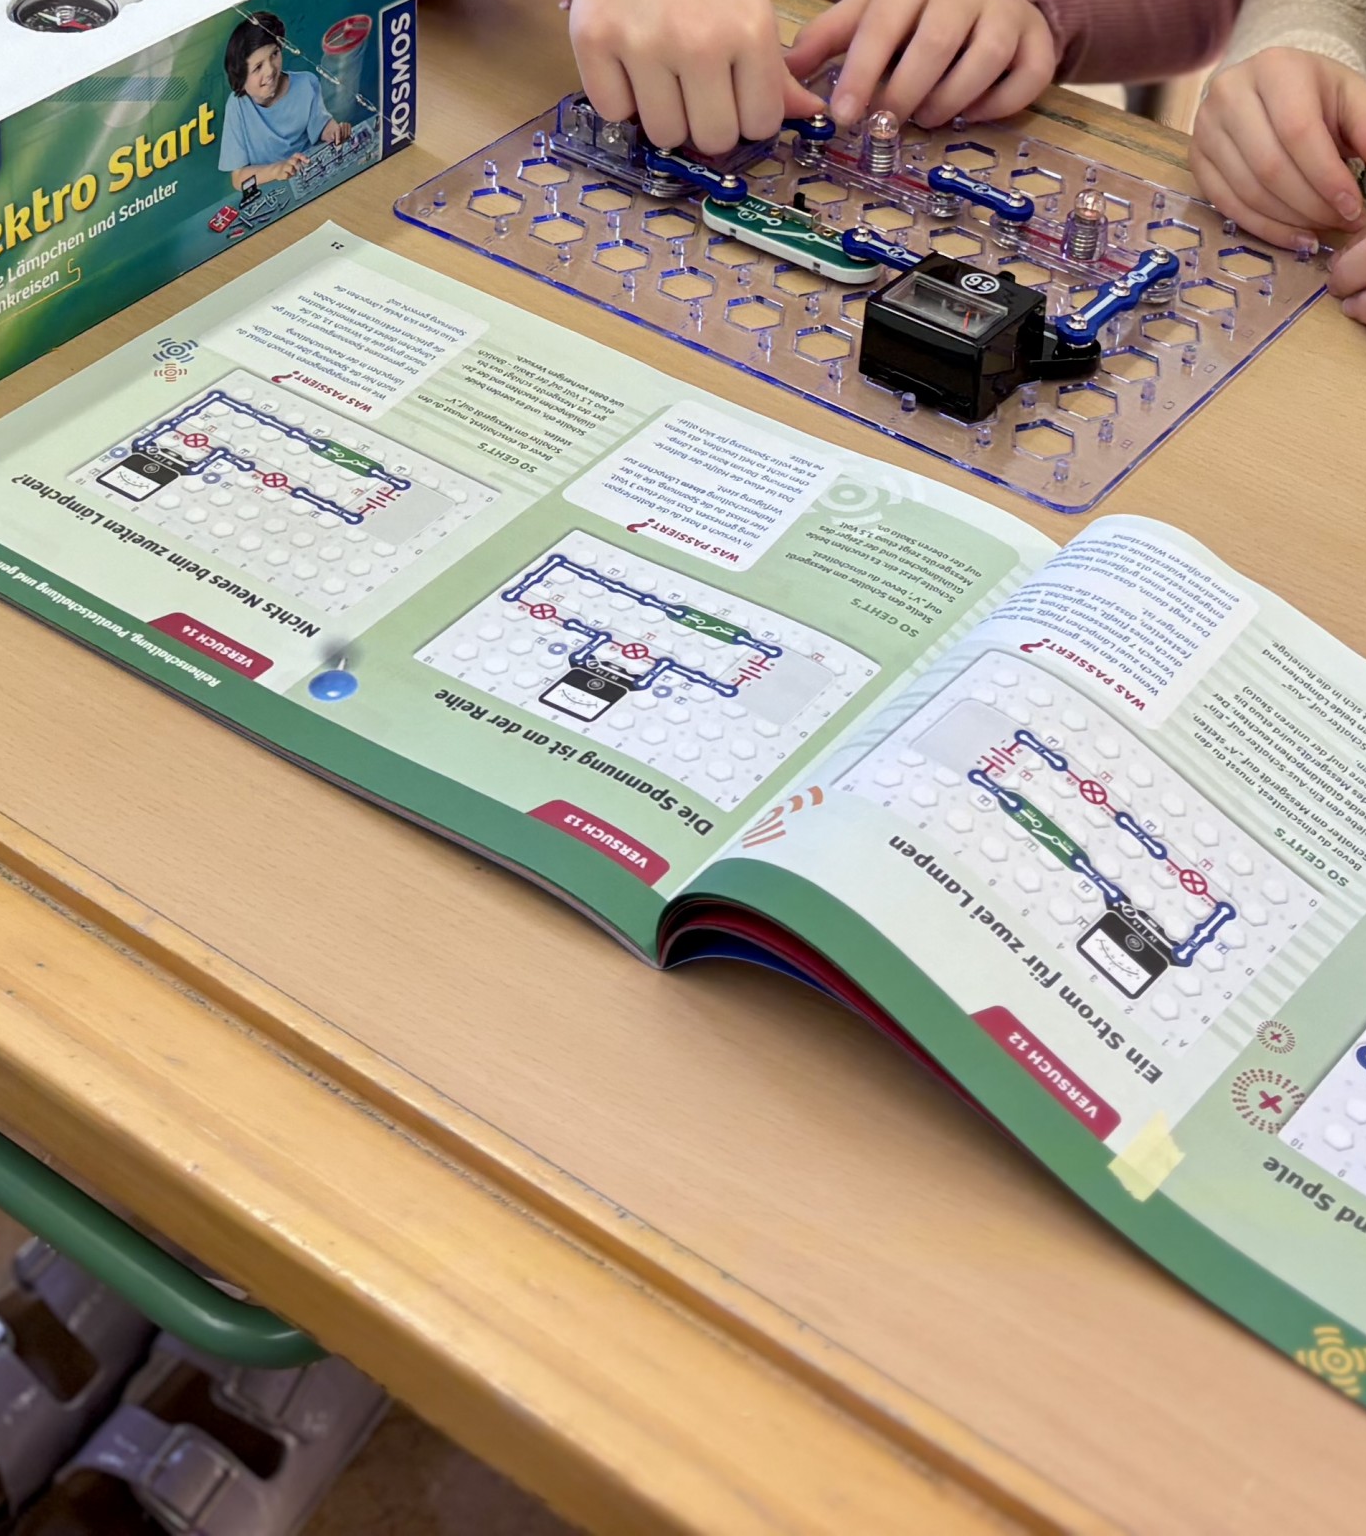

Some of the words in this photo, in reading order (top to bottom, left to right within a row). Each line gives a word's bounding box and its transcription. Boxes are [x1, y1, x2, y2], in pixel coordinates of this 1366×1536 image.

[388, 11, 412, 145] KOSMOS
[108, 103, 215, 193] Start
[4, 231, 85, 283] Lämpchen
[87, 210, 116, 239] und
[118, 179, 178, 222] Schalter
[329, 240, 345, 250] 21
[965, 274, 995, 293] 56
[270, 369, 348, 401] PASSIERT?
[345, 396, 373, 413] WAS
[518, 461, 538, 473] SO
[10, 473, 105, 525] Lämpchen?
[101, 518, 170, 557] zweiten
[625, 517, 711, 550] PASSIERT?
[166, 552, 211, 581] beim
[709, 545, 740, 563] WAS
[11, 571, 38, 587] und
[207, 574, 264, 608] Neues
[34, 581, 130, 638] Parallelschaltung
[260, 601, 321, 638] Nichts
[181, 624, 199, 637] 14
[898, 622, 919, 638] SO
[129, 632, 221, 687] Reihenschaltung,
[194, 632, 253, 668] VERSUCH
[1018, 637, 1115, 685] PASSIERT?
[433, 688, 489, 720] Reihe
[1113, 683, 1146, 711] WAS
[485, 714, 522, 734] der
[521, 728, 550, 746] an
[547, 740, 578, 761] ist
[576, 750, 678, 811] Spannung
[562, 813, 584, 827] 13
[676, 804, 714, 836] Die
[580, 822, 648, 868] VERSUCH
[888, 835, 974, 908] Lampen
[1326, 868, 1349, 887] SO
[968, 904, 1025, 954] zwei
[1021, 954, 1062, 989] für
[1058, 984, 1125, 1050] Strom
[1007, 1030, 1029, 1051] 12
[1124, 1046, 1163, 1084] Ein
[1026, 1049, 1098, 1118] VERSUCH
[1262, 1156, 1335, 1211] Spule
